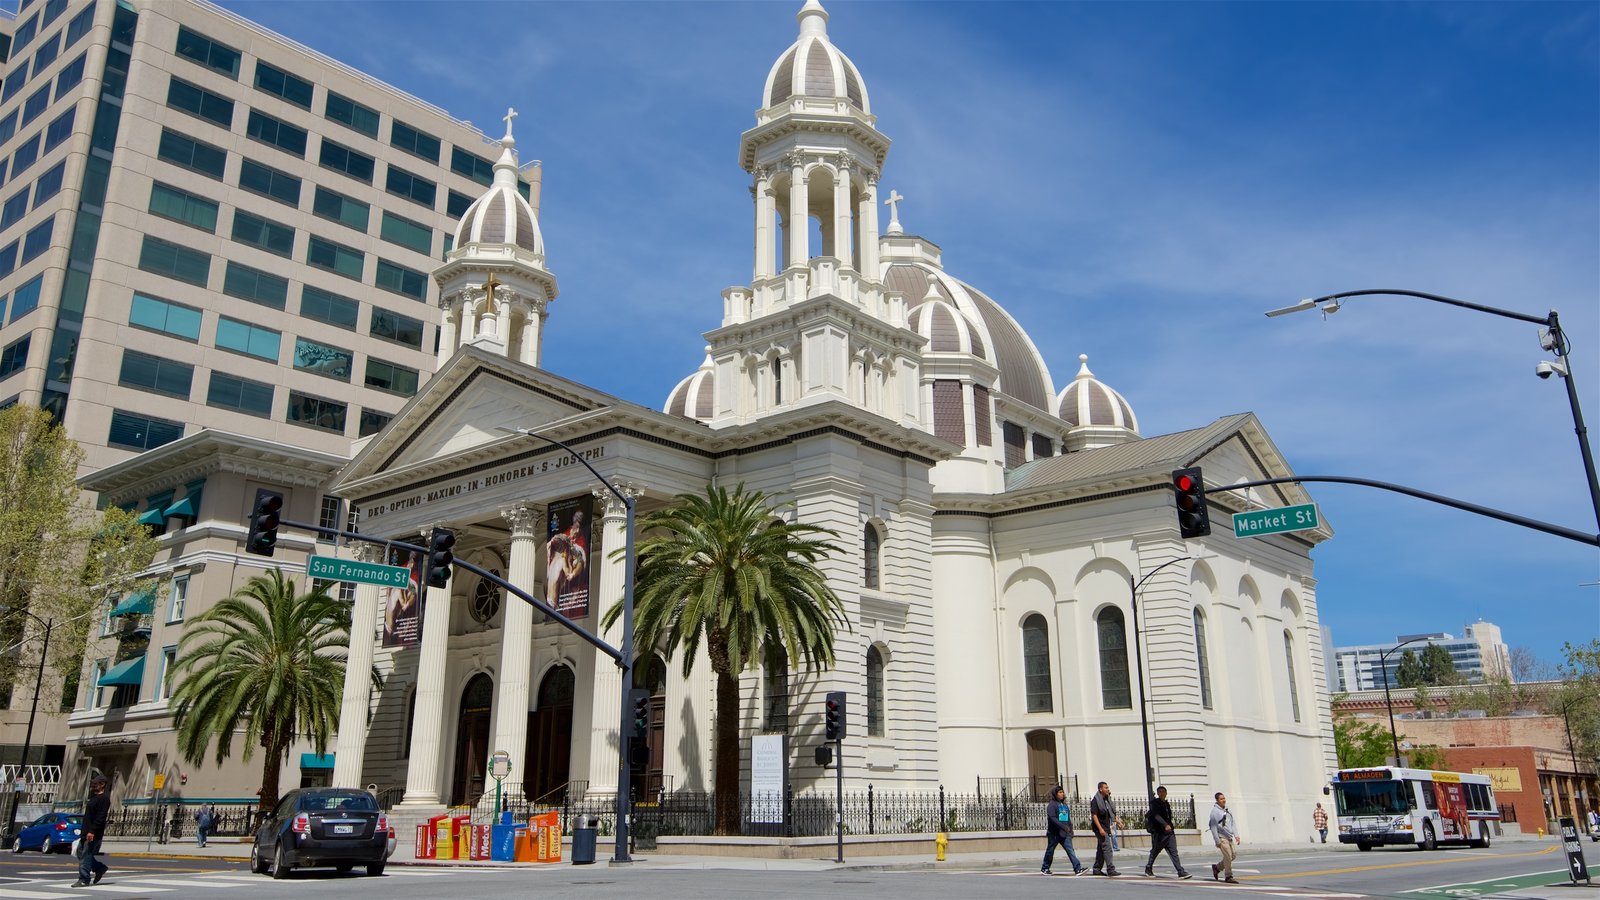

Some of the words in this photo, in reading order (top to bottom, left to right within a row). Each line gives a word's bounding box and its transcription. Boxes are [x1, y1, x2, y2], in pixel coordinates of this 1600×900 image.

[368, 506, 385, 518] DEO
[390, 495, 421, 512] OPTIMO
[427, 484, 461, 502] MAXIMO
[467, 480, 479, 492] IN
[485, 465, 535, 487] HONOREM
[541, 461, 548, 472] S
[1237, 513, 1287, 532] Market
[1295, 509, 1313, 524] St
[313, 560, 334, 574] San
[339, 564, 390, 581] Fernando
[394, 571, 407, 583] St
[1353, 771, 1384, 780] ALMADEN
[470, 825, 478, 858] Metro
[480, 825, 490, 857] Metro
